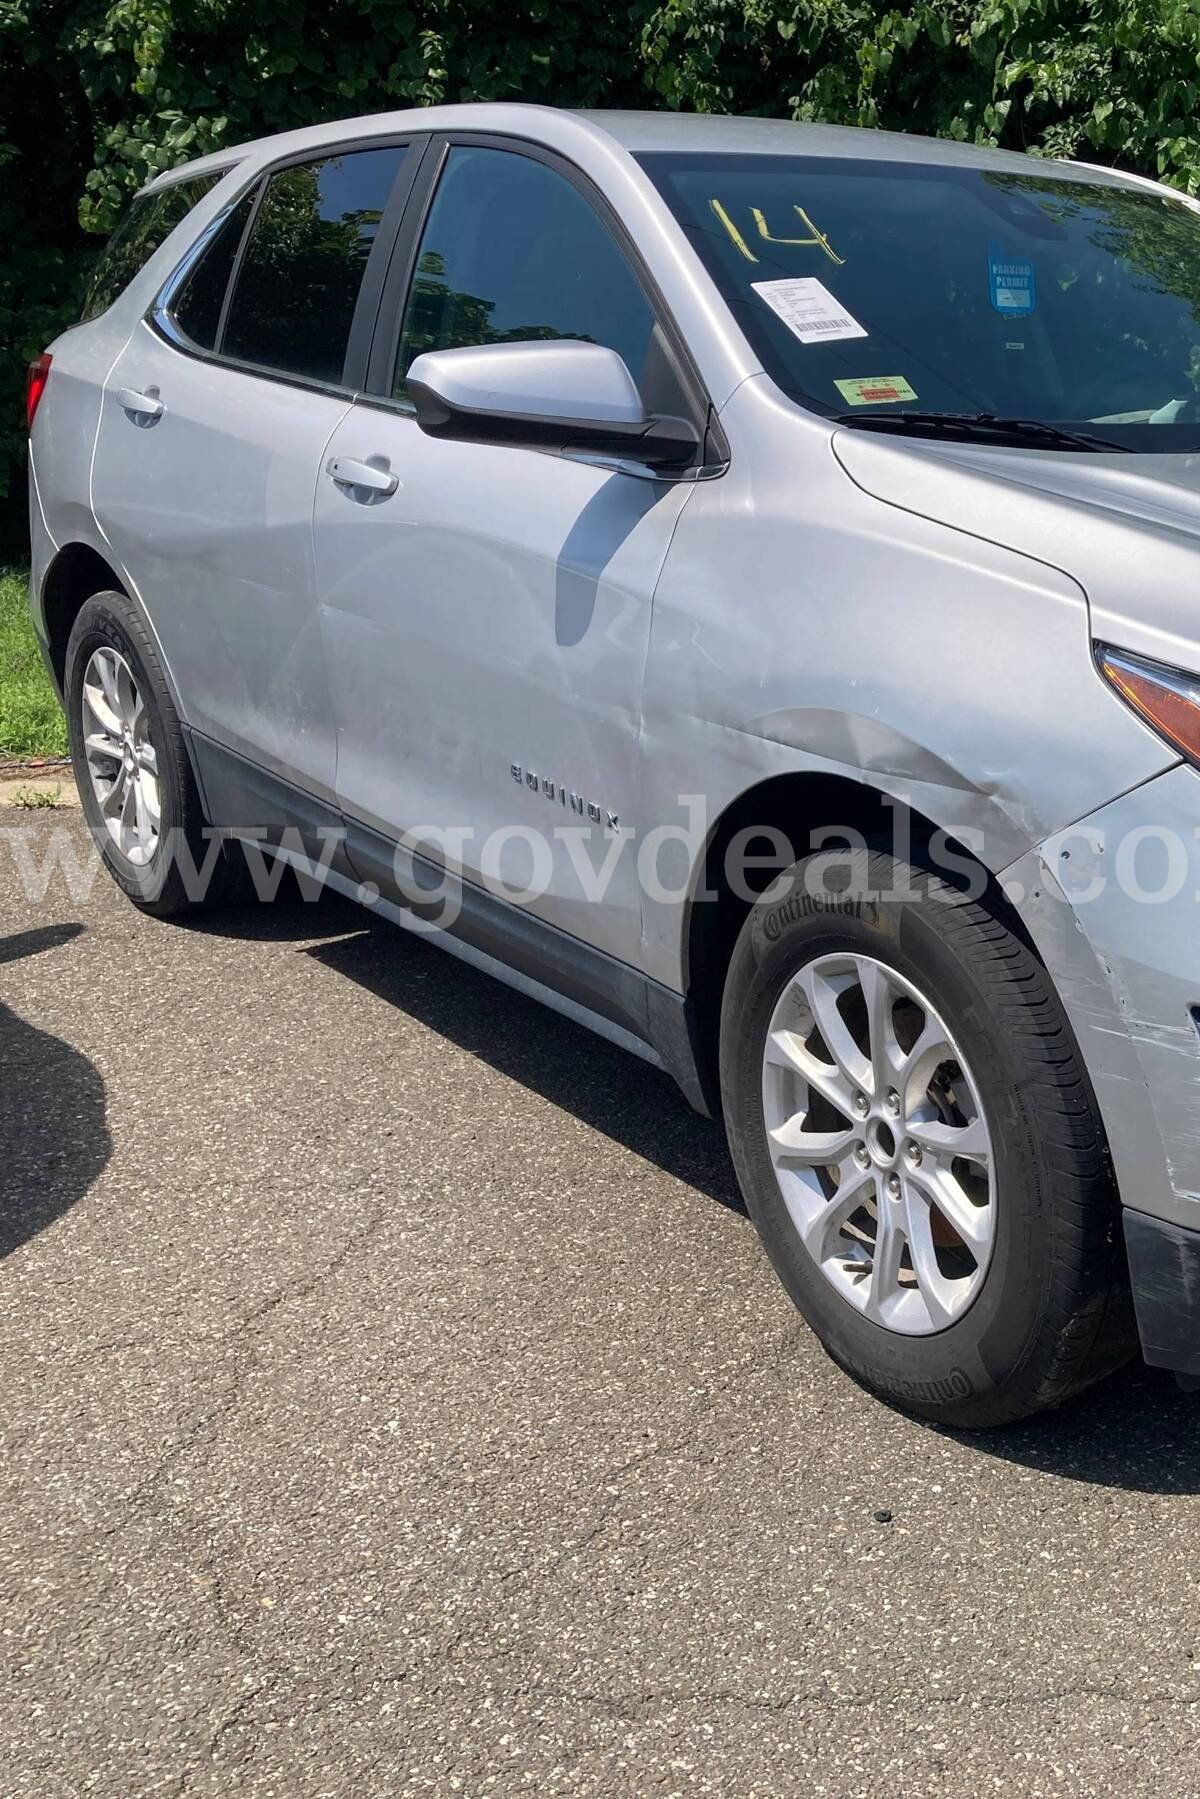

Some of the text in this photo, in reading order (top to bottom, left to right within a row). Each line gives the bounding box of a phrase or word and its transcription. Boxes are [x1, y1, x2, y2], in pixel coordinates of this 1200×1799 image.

[710, 199, 845, 264] 14
[996, 276, 1028, 288] PERMIT
[510, 762, 621, 834] EQUINOX
